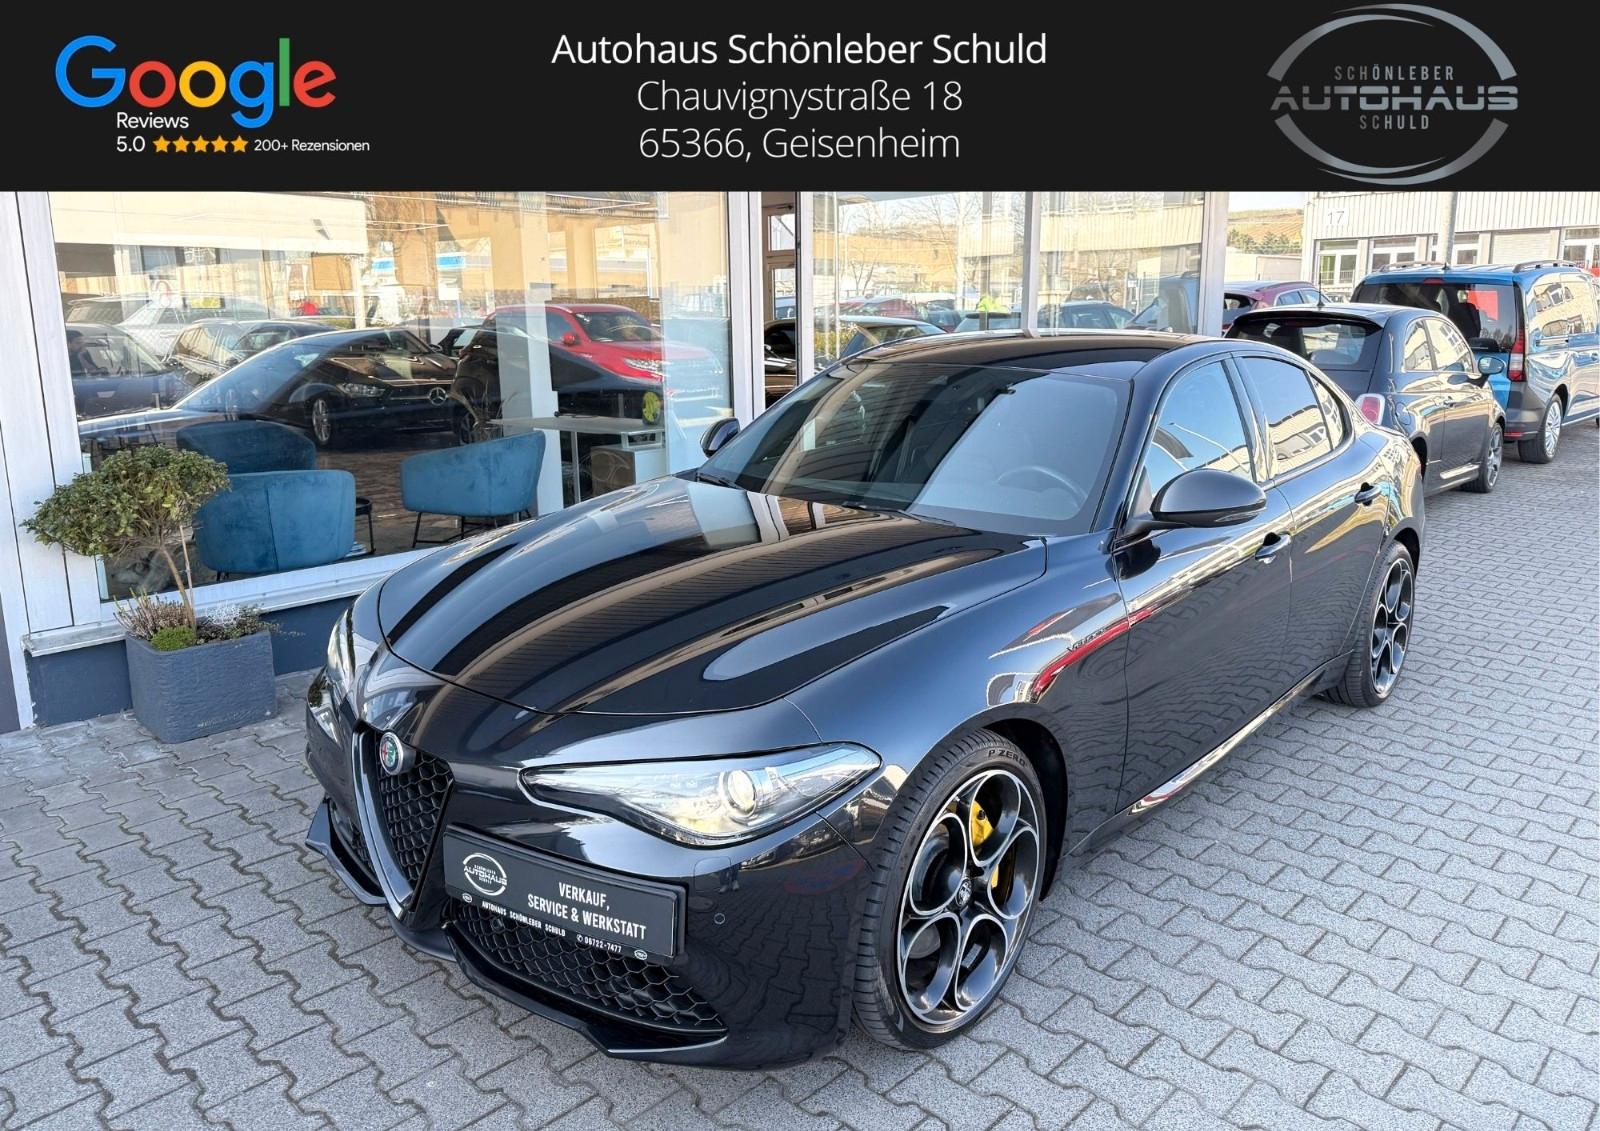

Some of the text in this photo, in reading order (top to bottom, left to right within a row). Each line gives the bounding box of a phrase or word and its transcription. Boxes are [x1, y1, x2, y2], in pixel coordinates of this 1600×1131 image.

[1328, 210, 1344, 224] 17
[988, 749, 1026, 766] P ZERO
[463, 865, 508, 886] AUTOHAUS
[558, 881, 610, 911] VERKAUF,
[482, 900, 507, 916] AUTOHAUS
[544, 923, 566, 937] SCHULD
[584, 936, 622, 953] 06722-7477
[527, 893, 647, 940] SERVICE & WERKSTATT
